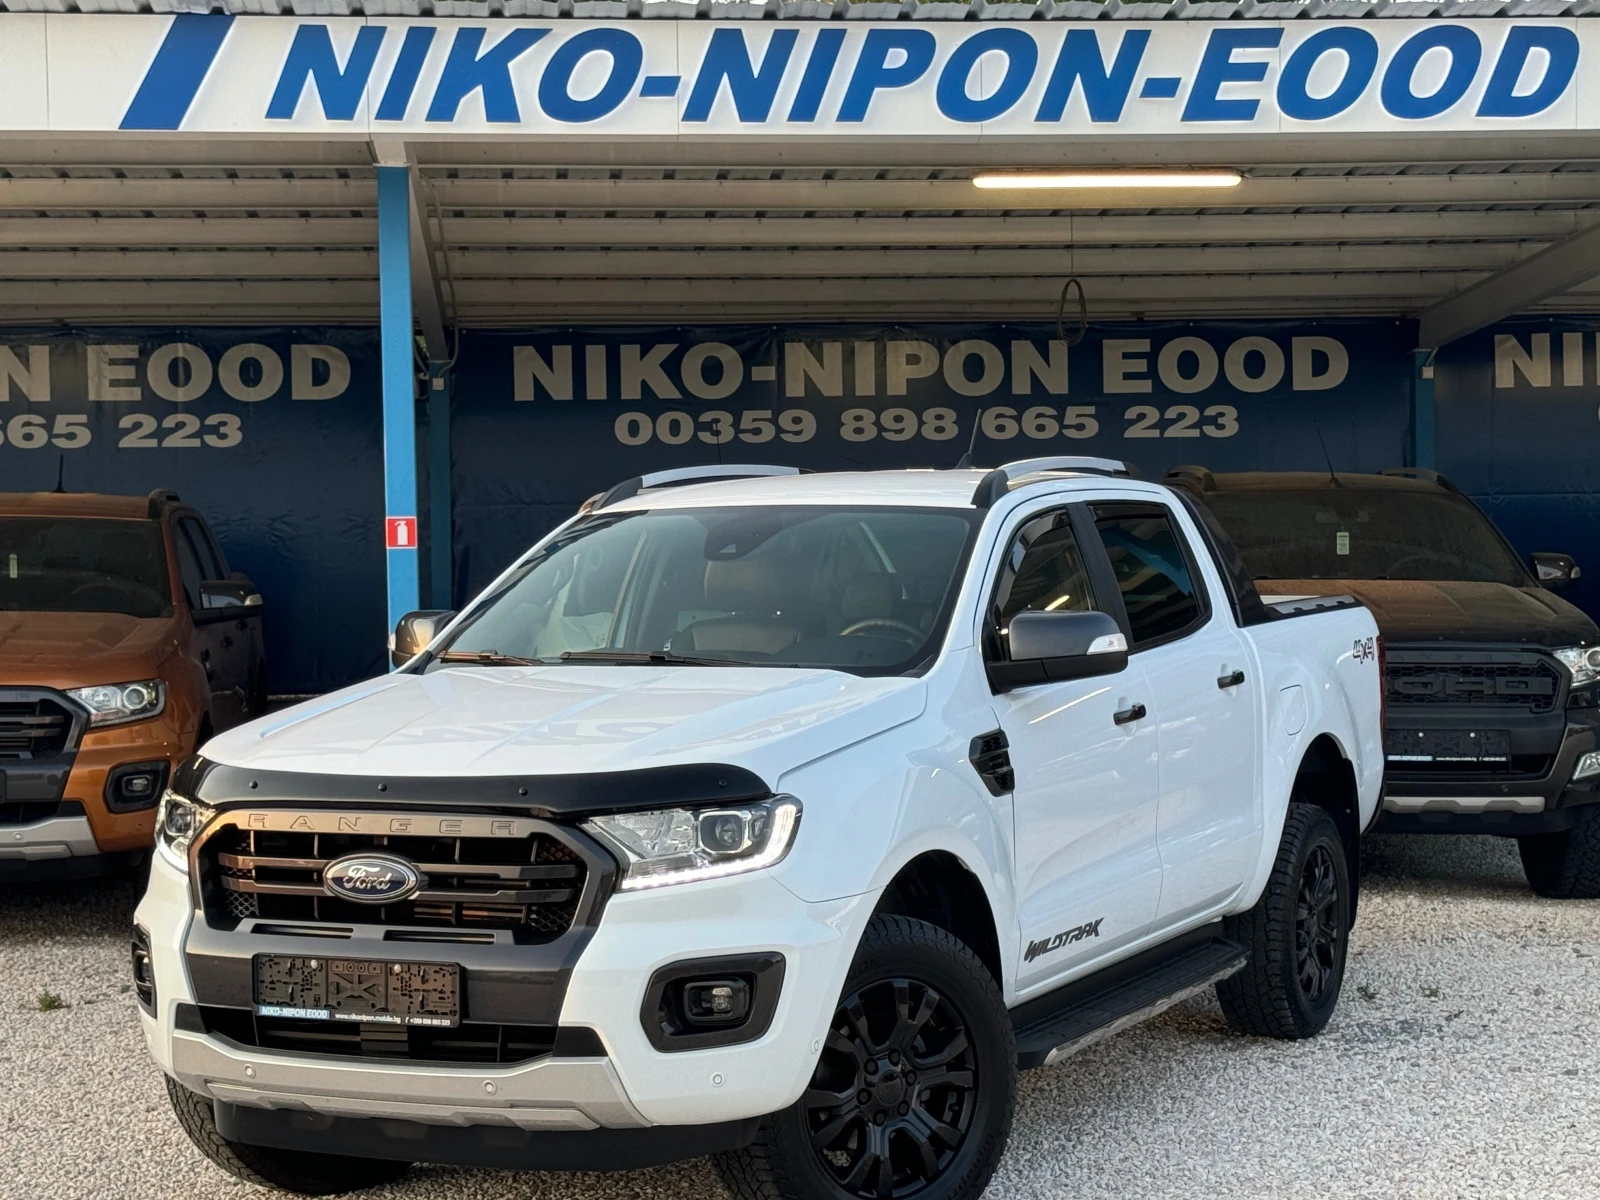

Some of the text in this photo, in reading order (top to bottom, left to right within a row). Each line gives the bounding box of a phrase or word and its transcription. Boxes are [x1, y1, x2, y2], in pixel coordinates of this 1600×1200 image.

[267, 25, 1580, 122] NIKO-NIPON-EOOD
[87, 342, 351, 402] EOOD
[513, 336, 1350, 402] NIKO-NIPON EOOD
[1494, 332, 1600, 388] NI
[0, 413, 243, 449] 65 223
[614, 405, 1239, 446] 00359 898 665 223
[248, 813, 516, 835] RANGER
[343, 865, 392, 891] Ford
[1024, 917, 1104, 963] WILDTRAK
